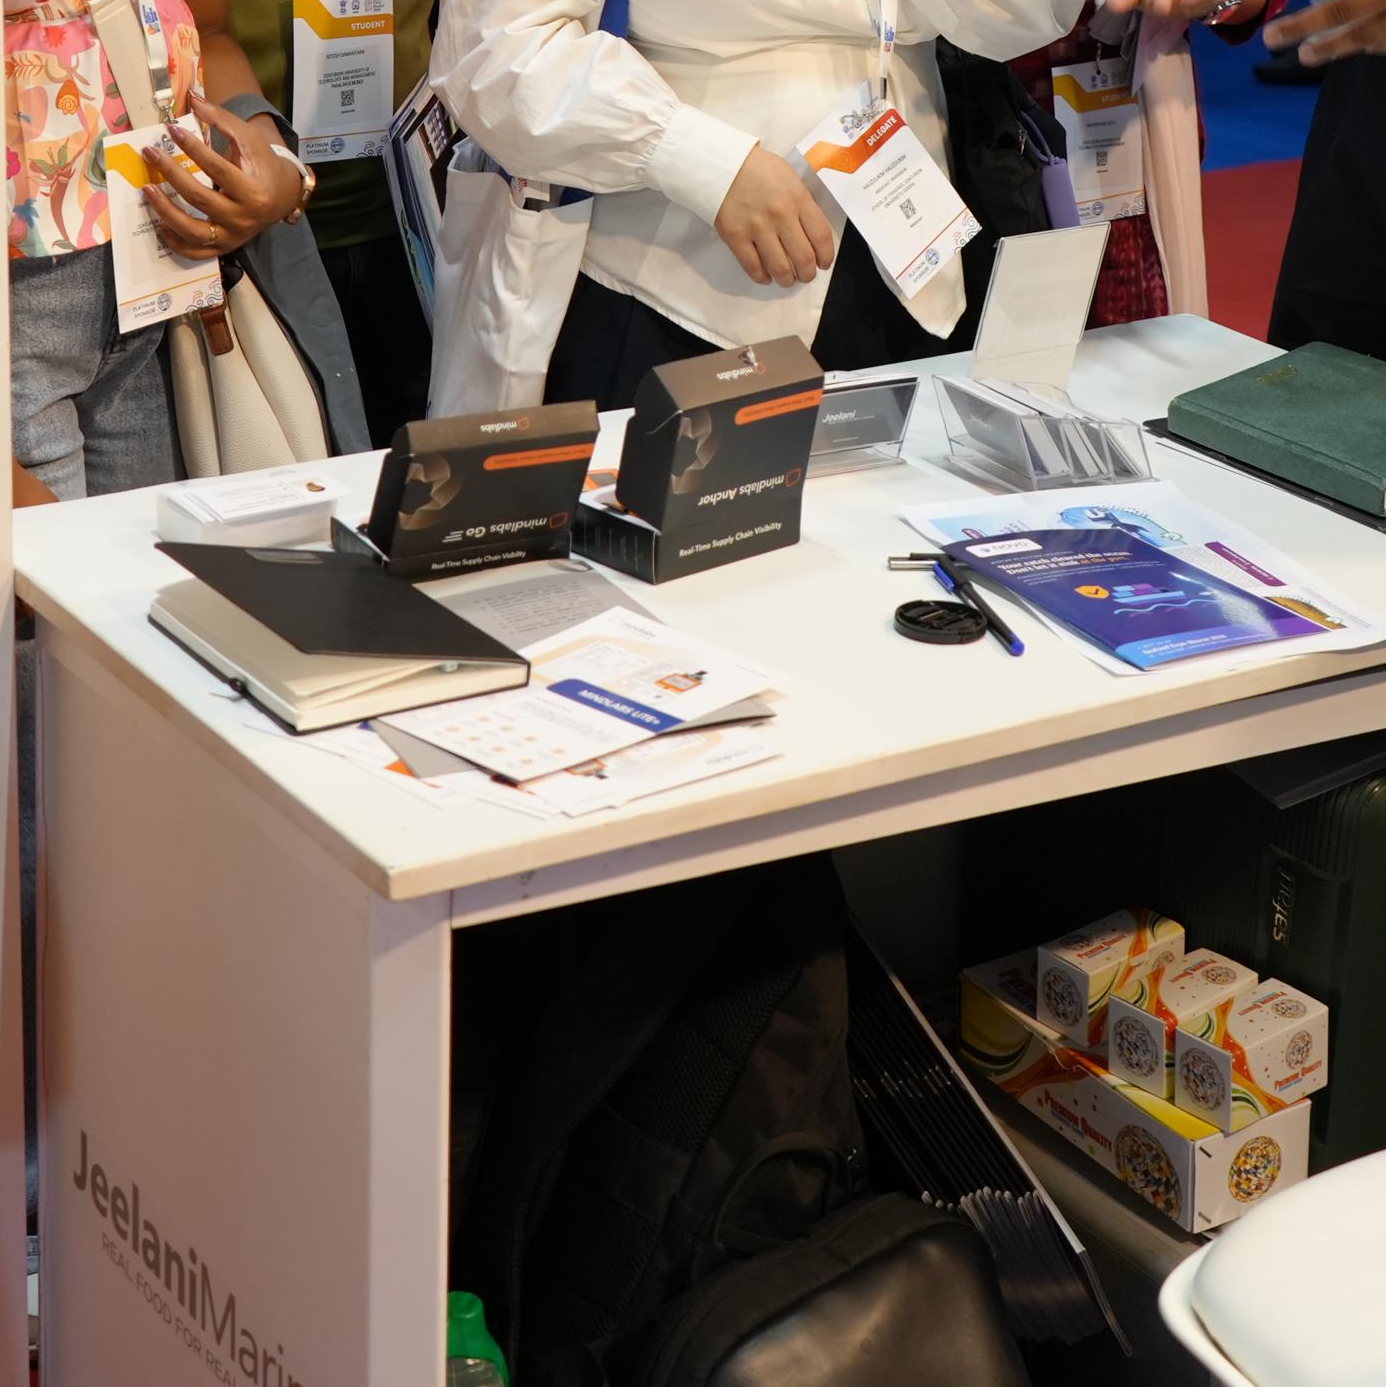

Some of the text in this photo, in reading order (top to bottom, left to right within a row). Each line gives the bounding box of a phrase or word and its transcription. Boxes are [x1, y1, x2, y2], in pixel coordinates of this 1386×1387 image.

[350, 20, 387, 31] STUDENT
[866, 115, 898, 147] DELEGATE
[480, 420, 517, 434] mindlabs
[697, 474, 785, 507] mindlabs Anchor
[465, 516, 548, 539] mindlabs Go
[678, 521, 783, 558] Real-Time Supply Chain Visibility
[430, 549, 527, 571] Real-Time Supply Chain Visibility
[997, 561, 1023, 571] Your
[578, 688, 635, 716] MINDLABS
[73, 1128, 305, 1387] JeelaniMari
[101, 1230, 134, 1283] REAL
[135, 1271, 173, 1325] FOOD
[174, 1316, 202, 1359] FOR
